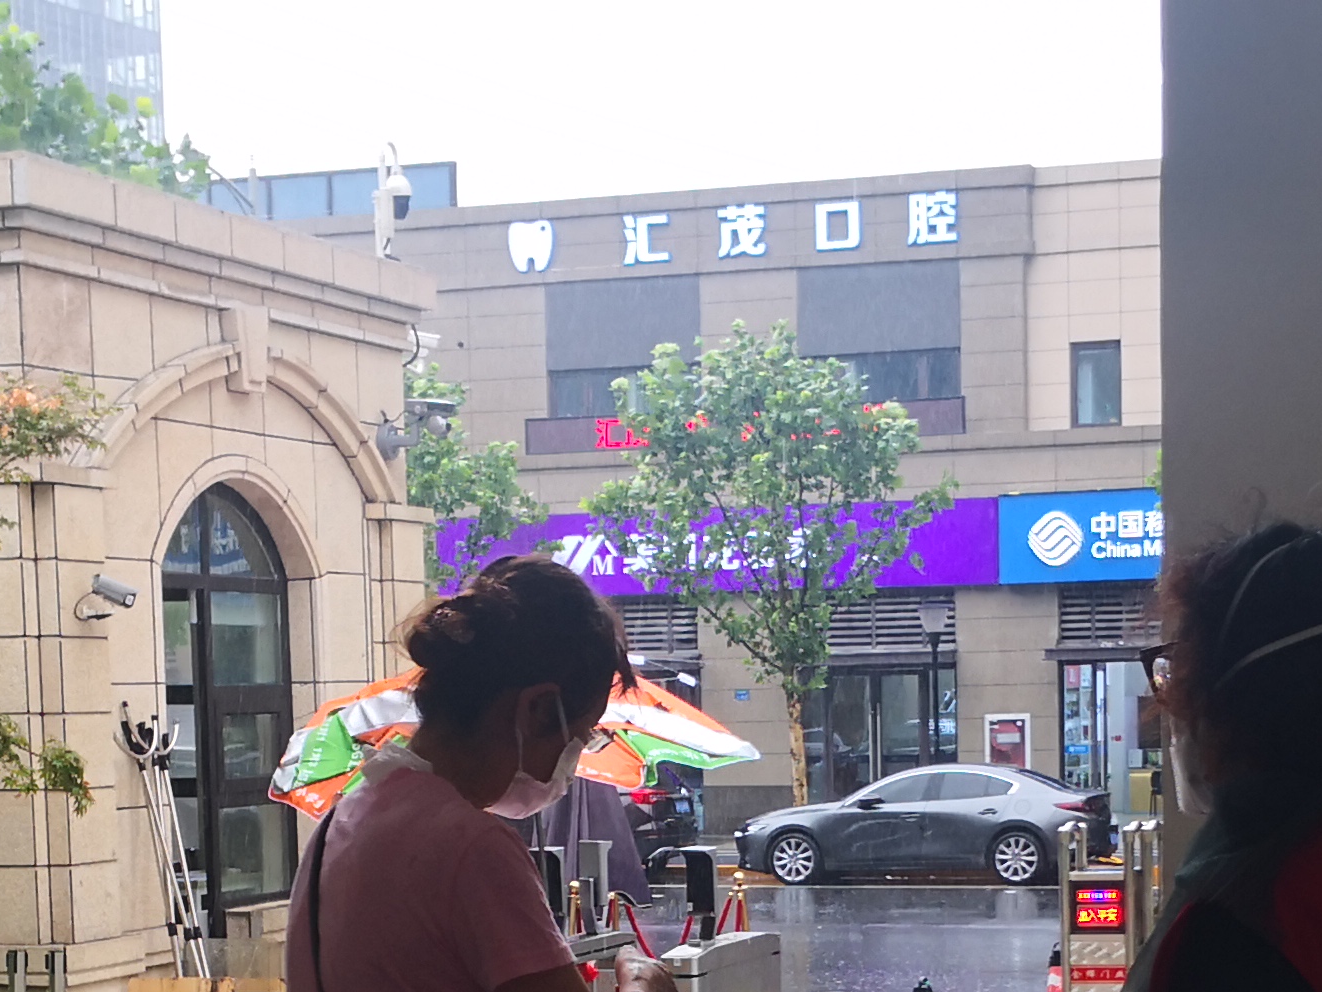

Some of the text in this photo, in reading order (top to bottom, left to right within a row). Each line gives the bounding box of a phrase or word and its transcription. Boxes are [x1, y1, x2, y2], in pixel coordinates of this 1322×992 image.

[622, 191, 959, 266] 汇茂口腔
[1090, 539, 1165, 559] China M
